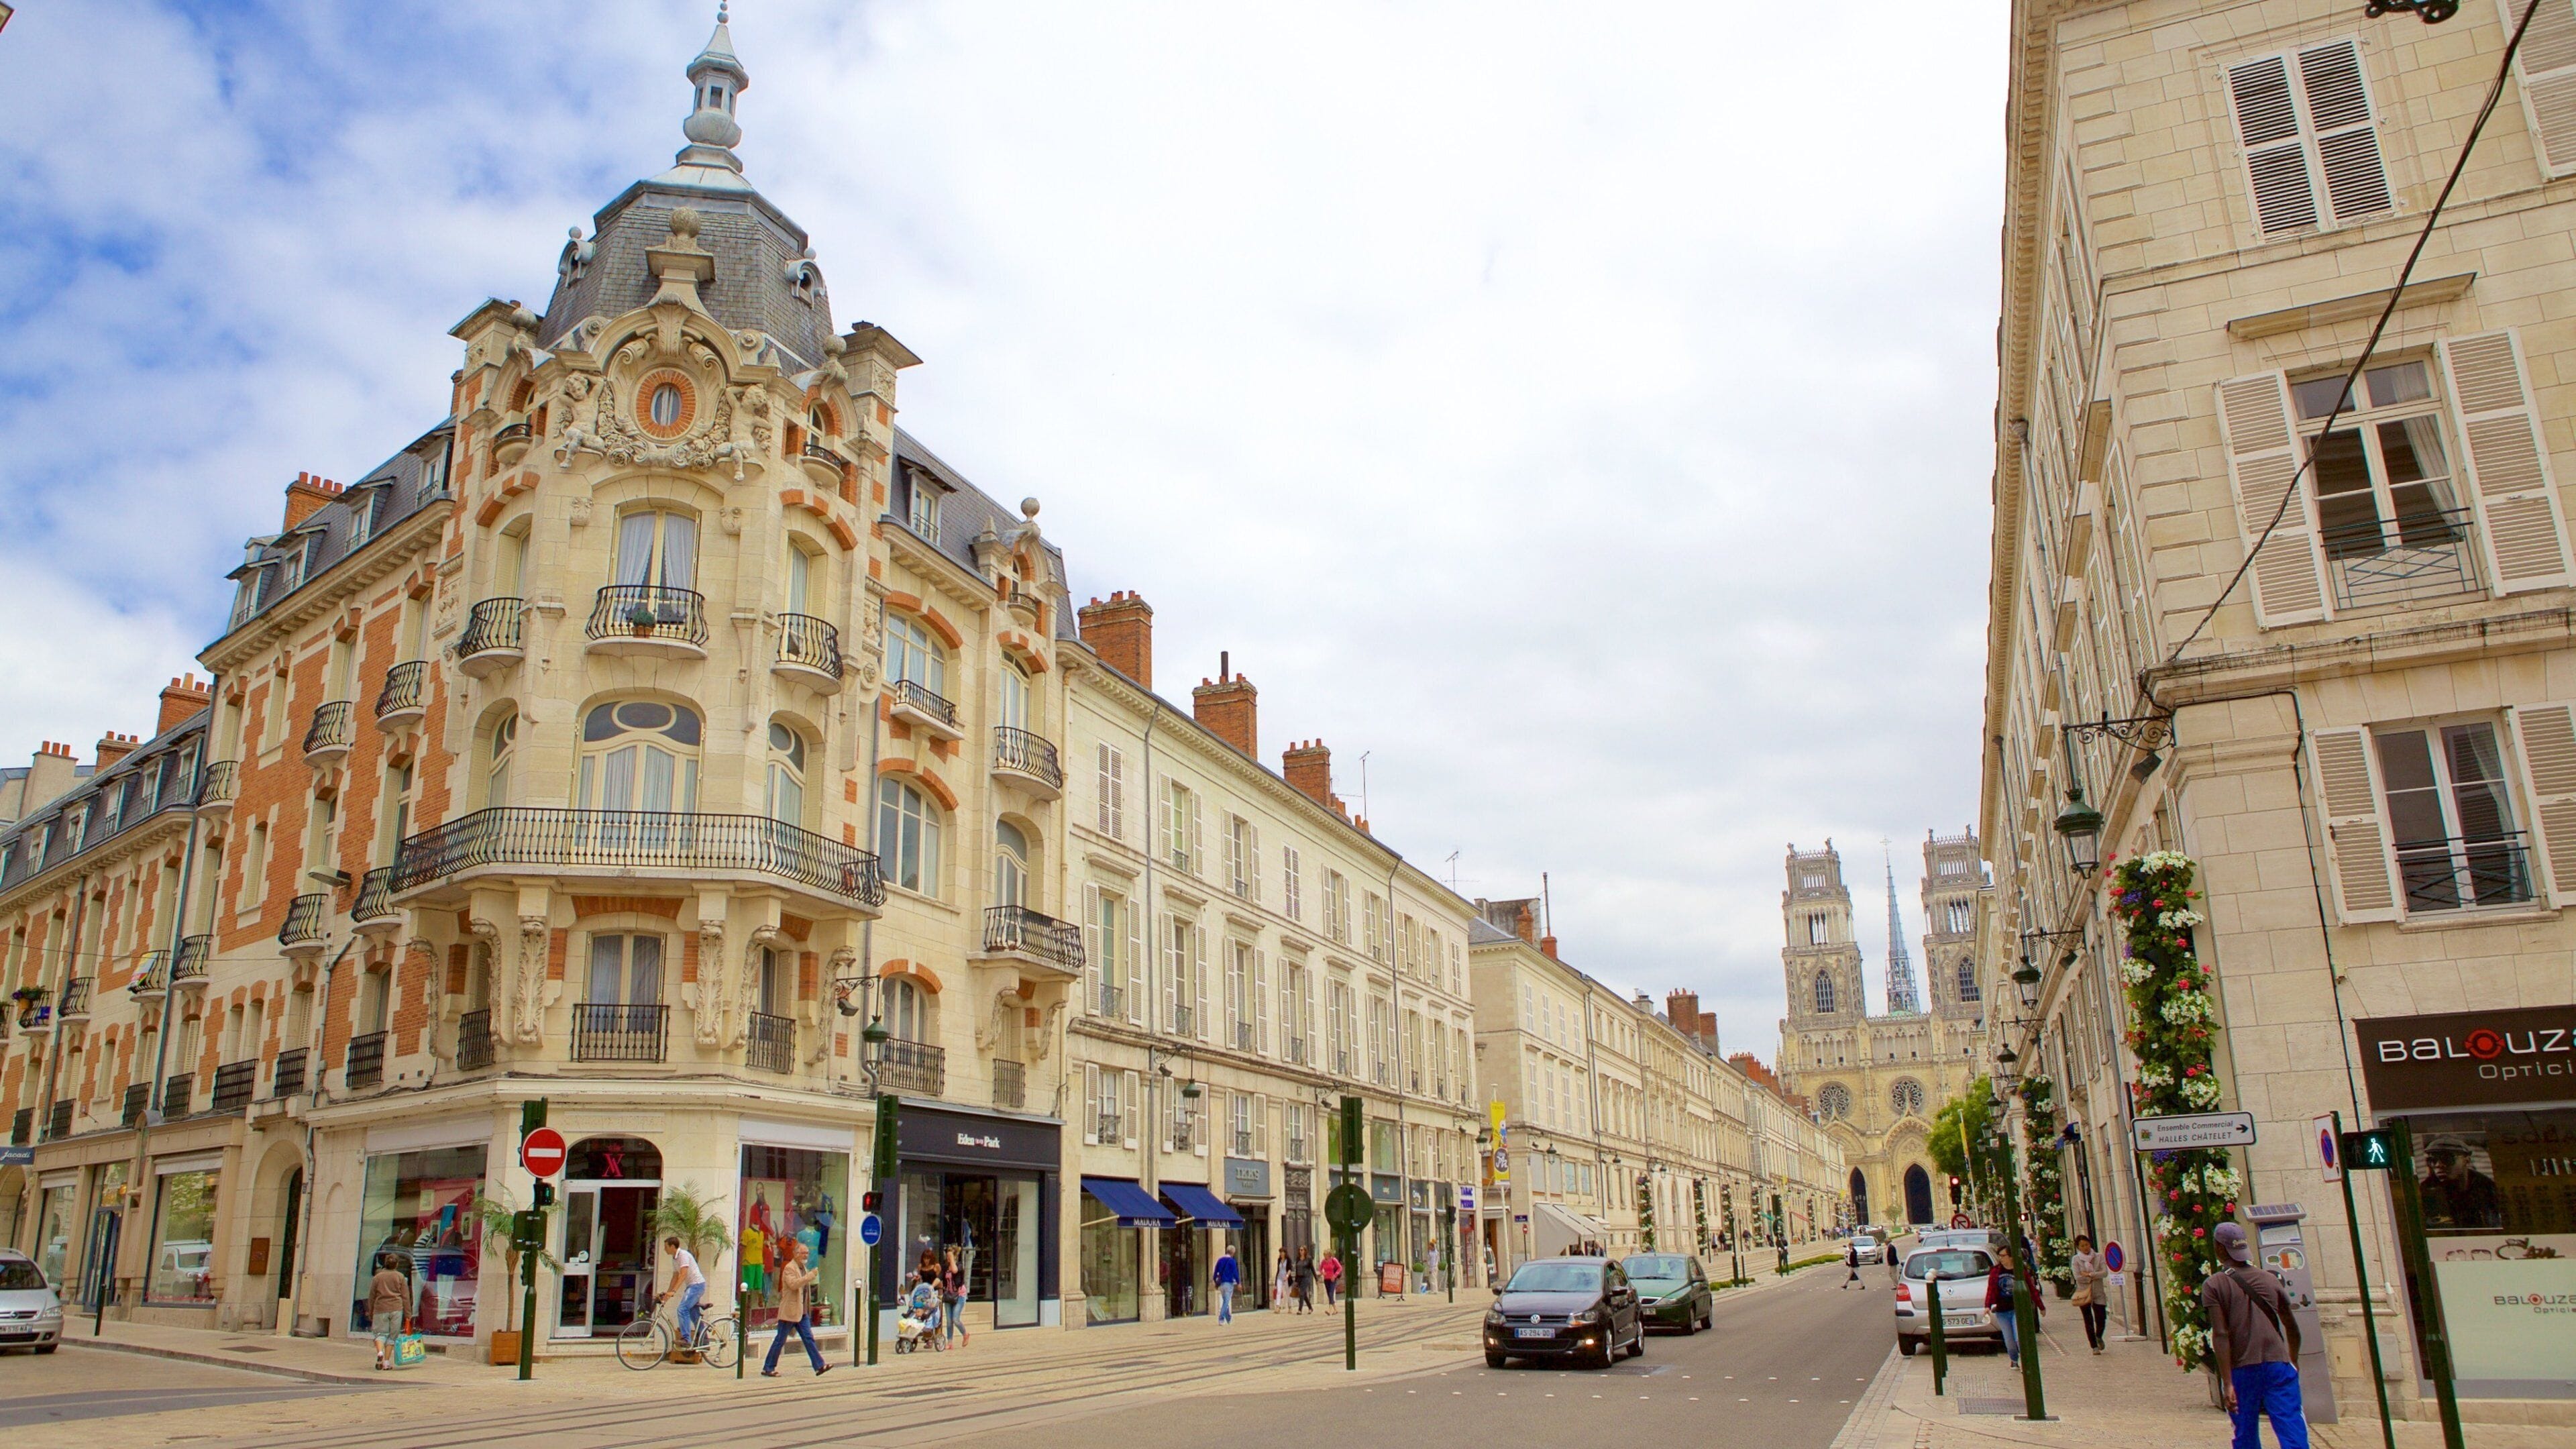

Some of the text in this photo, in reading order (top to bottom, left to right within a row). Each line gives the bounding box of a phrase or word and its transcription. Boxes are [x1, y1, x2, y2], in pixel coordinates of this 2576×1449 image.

[2157, 1120, 2233, 1132] Ensemble Commercial
[957, 1132, 1000, 1148] Eden Park
[2159, 1131, 2232, 1143] HALLES CHÂTELET
[0, 1150, 32, 1161] Jacadi
[1134, 1218, 1161, 1226] MADURA
